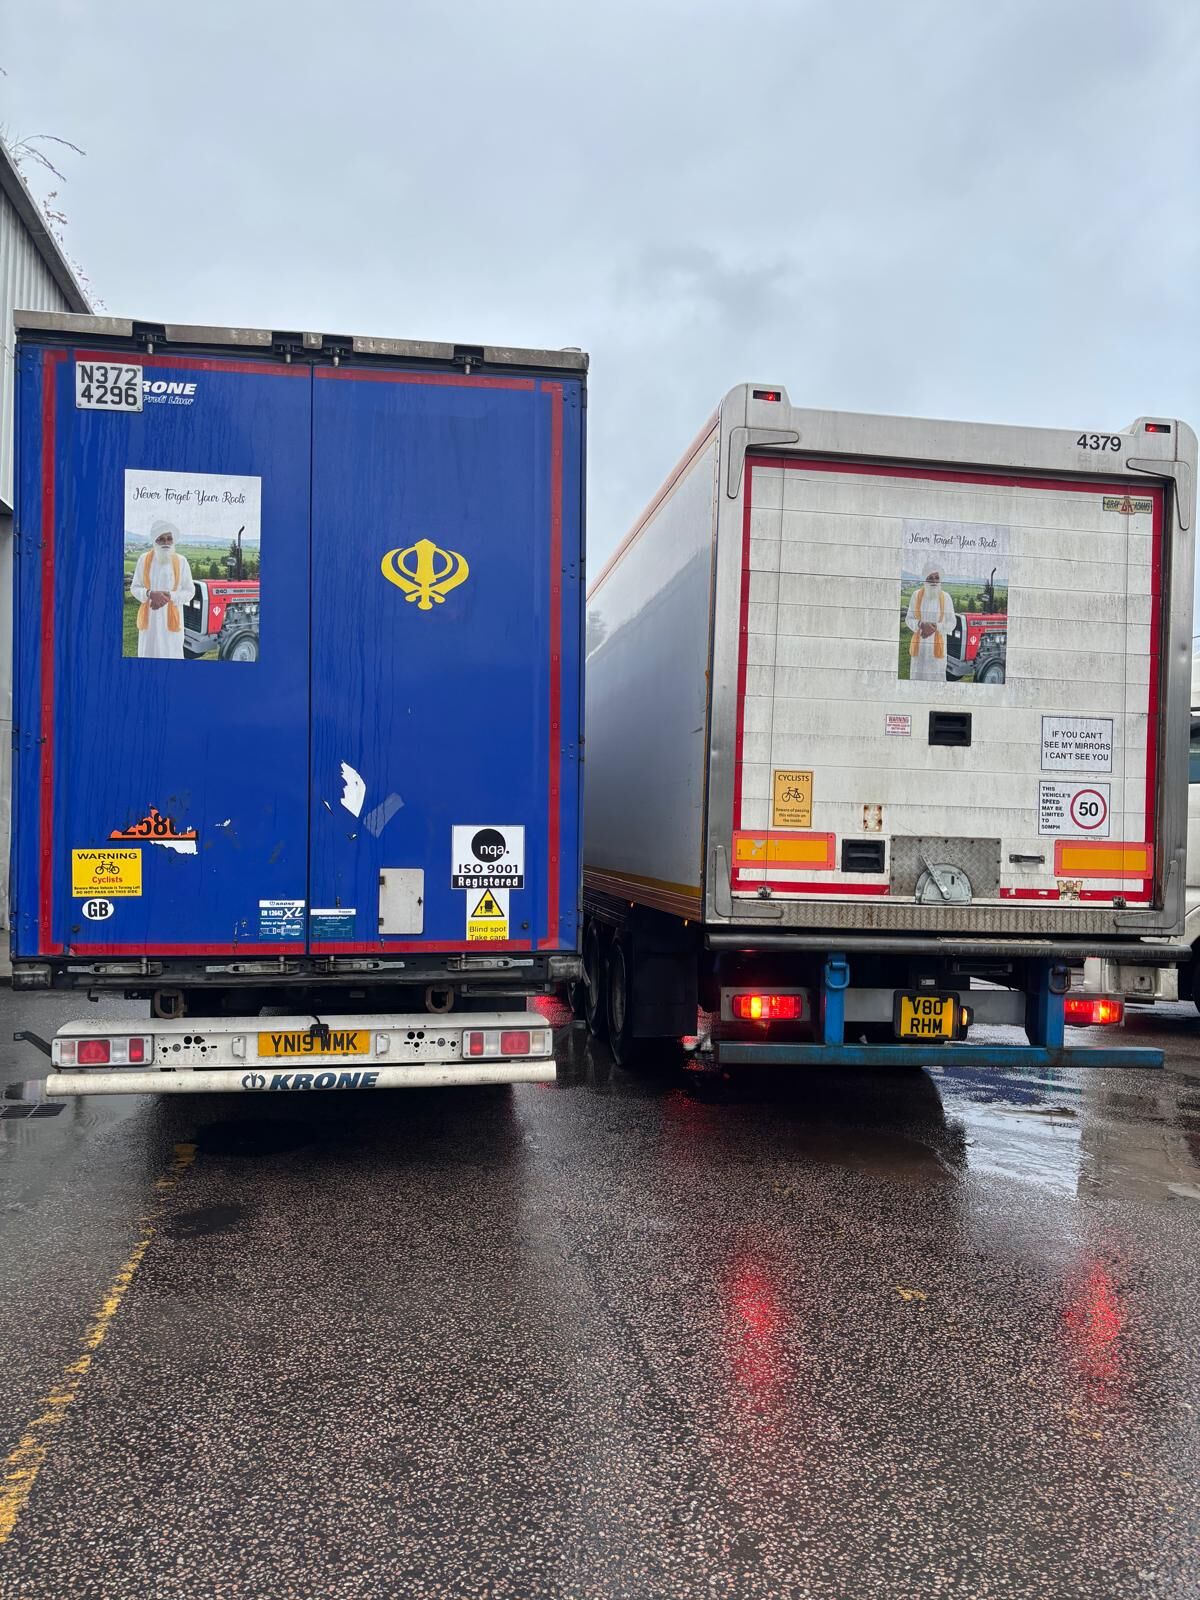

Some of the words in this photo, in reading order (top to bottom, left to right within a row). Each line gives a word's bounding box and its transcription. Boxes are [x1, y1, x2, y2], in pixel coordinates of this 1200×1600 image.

[80, 365, 137, 386] N372
[81, 384, 137, 406] 4296
[142, 381, 197, 395] RONE
[168, 395, 194, 405] Liner
[1077, 434, 1121, 452] 4379
[133, 486, 161, 500] Never
[165, 488, 192, 504] Forget
[194, 490, 219, 505] Your
[222, 491, 246, 504] Roots
[909, 532, 930, 544] Never
[934, 534, 954, 546] Forget
[957, 535, 976, 548] Your
[978, 537, 997, 548] Roots
[1044, 741, 1059, 749] SEE
[1075, 742, 1110, 750] MIRRORS
[1079, 802, 1099, 816] 50
[77, 852, 137, 860] WARNING
[459, 864, 483, 874] ISO
[487, 864, 518, 874] 9001
[92, 876, 123, 884] Cyclists
[458, 877, 518, 888] Registered
[87, 901, 109, 918] GB
[282, 907, 303, 920] XL
[490, 926, 506, 934] spot
[912, 999, 943, 1015] V80
[910, 1018, 942, 1033] RHM
[272, 1035, 313, 1052] YN19
[320, 1033, 358, 1051] WMK
[269, 1072, 380, 1090] KRONE
